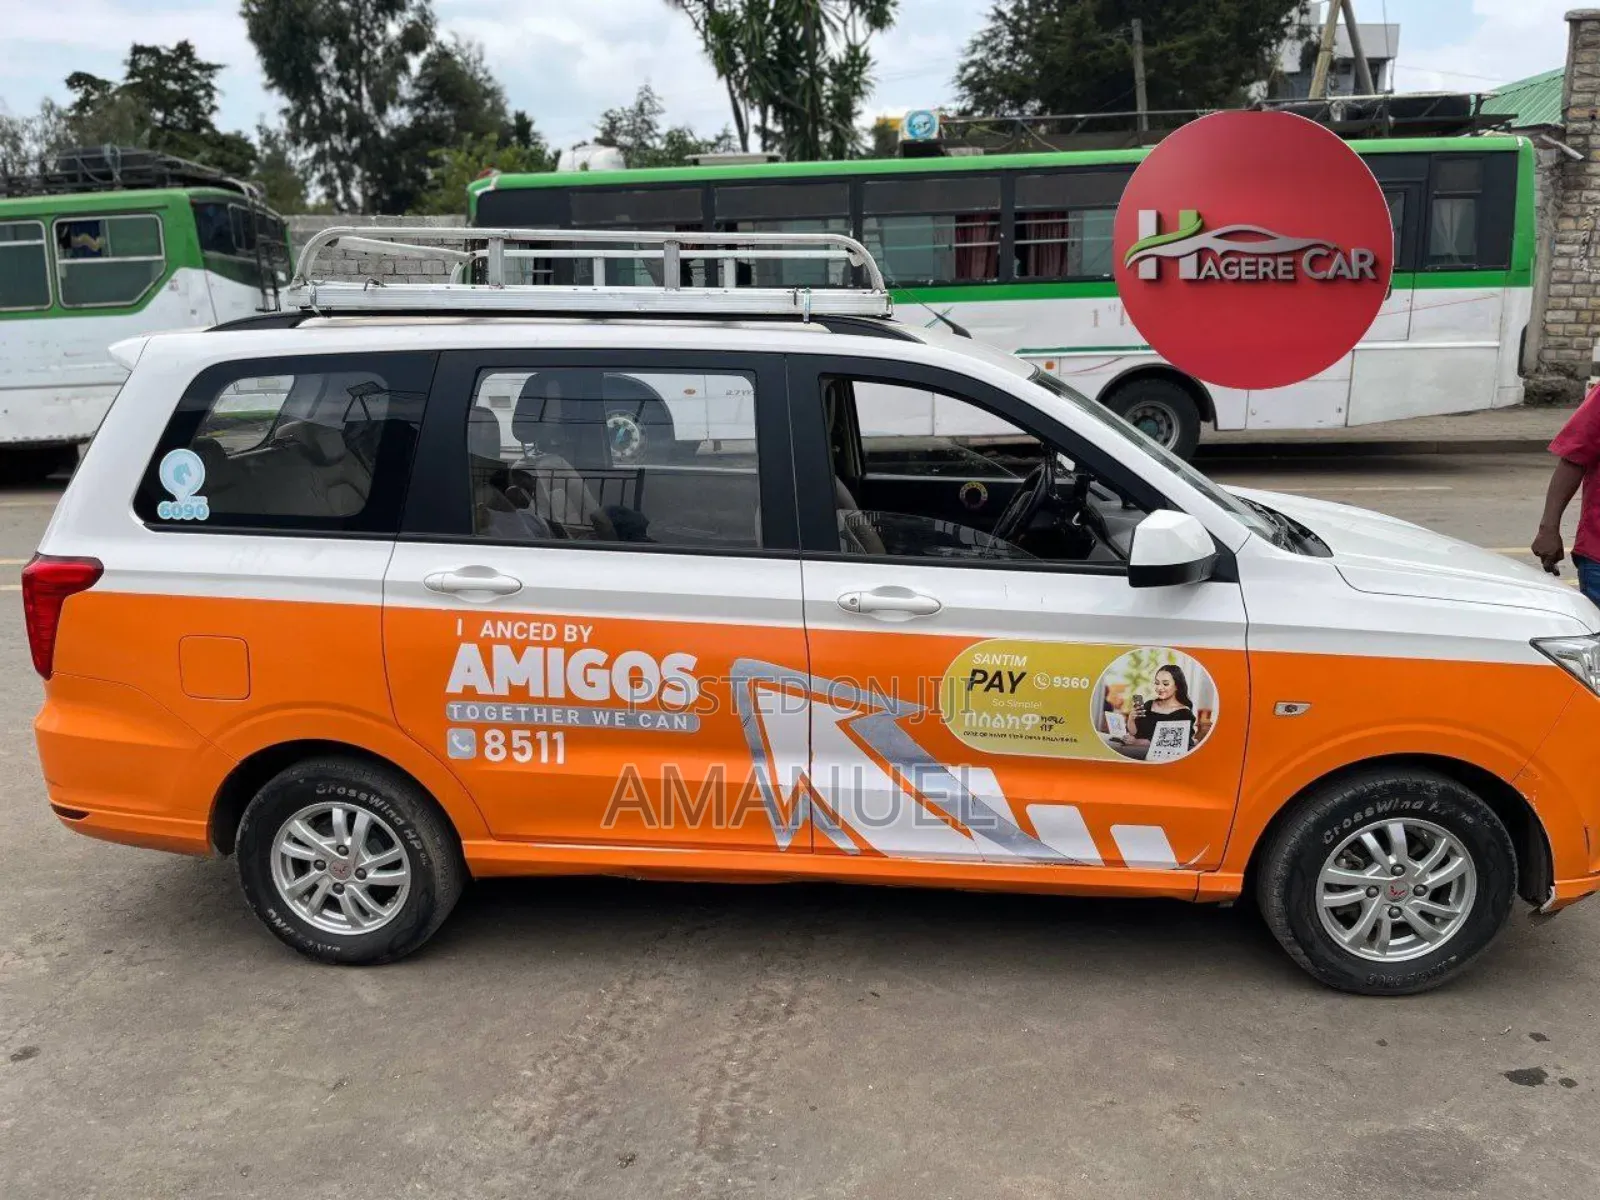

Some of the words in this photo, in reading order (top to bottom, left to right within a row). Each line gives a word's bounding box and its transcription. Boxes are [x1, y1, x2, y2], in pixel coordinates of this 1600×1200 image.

[564, 624, 594, 644] BY
[972, 653, 1028, 668] SANTIM
[445, 642, 701, 707] AMIGOS
[968, 668, 1027, 694] PAY
[1052, 674, 1091, 690] 9360
[992, 698, 1005, 708] So
[1008, 699, 1042, 711] Simple!
[449, 704, 580, 725] TOGETHER
[592, 710, 626, 728] WE
[638, 713, 689, 730] CAN
[483, 728, 566, 765] 8511
